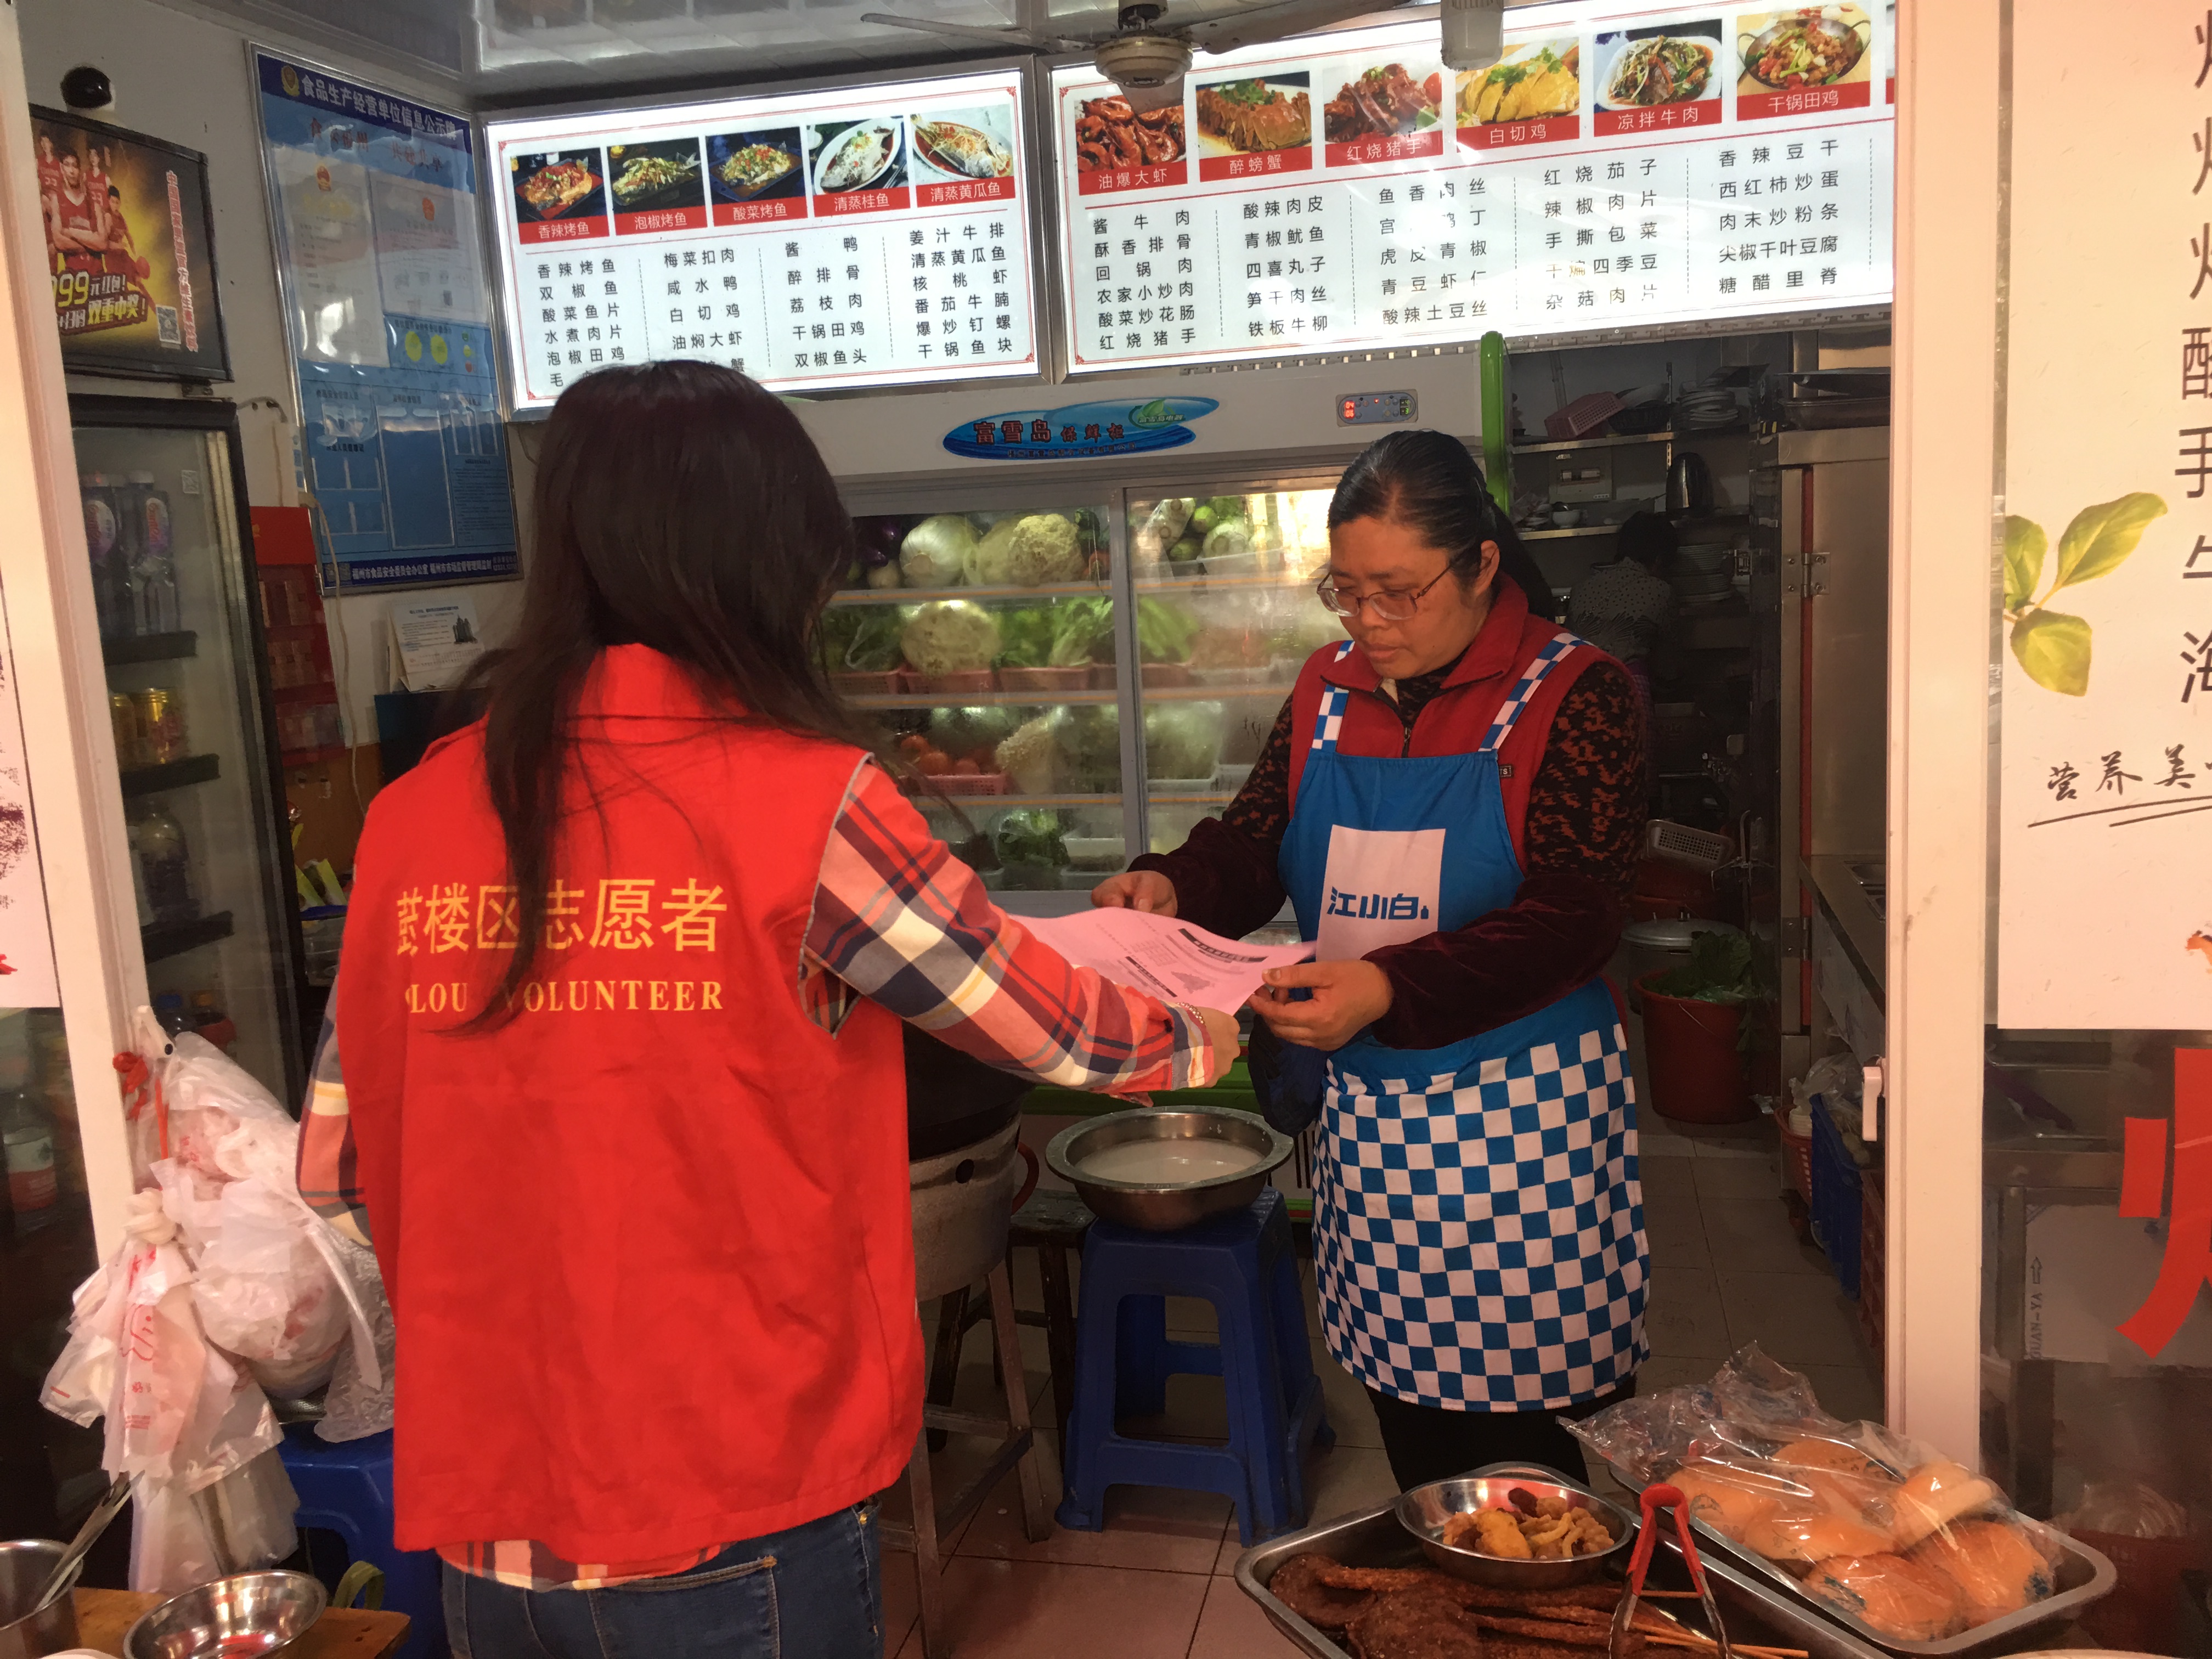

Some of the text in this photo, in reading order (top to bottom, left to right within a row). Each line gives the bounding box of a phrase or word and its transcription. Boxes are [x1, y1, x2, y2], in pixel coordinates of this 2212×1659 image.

[1768, 89, 1838, 113] 干锅田鸡
[1618, 107, 1698, 129] 凉拌牛肉
[1490, 123, 1546, 144] 白切鸡
[1347, 138, 1421, 160] 红烧猪手
[1719, 140, 1838, 167] 香辣豆干
[1229, 154, 1282, 174] 醉螃蟹
[1544, 159, 1657, 185] 红烧茄子
[1098, 168, 1167, 189] 油爆大虾
[1719, 171, 1838, 199] 西红柿炒蛋
[834, 193, 890, 211] 清蒸桂鱼
[930, 182, 1001, 202] 清蒸黄瓜鱼
[1379, 178, 1485, 204] 鱼香肉丝
[732, 203, 788, 220] 酸菜烤鱼
[1243, 195, 1323, 220] 酸辣肉皮
[1545, 190, 1657, 218] 辣椒肉片
[634, 212, 688, 230] 泡椒烤鱼
[1093, 210, 1189, 234] 酱牛肉
[1380, 210, 1486, 235] 宫丁
[1719, 202, 1838, 230] 肉末炒粉条
[538, 222, 590, 239] 香辣烤鱼
[909, 222, 1004, 246] 姜汁牛排
[1244, 226, 1324, 249] 青椒鱿鱼
[1545, 222, 1657, 249] 手撕包菜
[785, 236, 858, 257] 酱鸭
[911, 245, 1006, 268] 清蒸黄瓜鱼
[1094, 234, 1191, 258] 酥香排骨
[1381, 240, 1486, 265] 虎皮青椒
[538, 258, 616, 279] 香辣烤鱼
[664, 247, 735, 268] 梅菜扣肉
[1246, 256, 1325, 279] 四喜丸子
[1546, 254, 1657, 279] 干煸四季豆
[788, 265, 860, 285] 醉排骨
[913, 269, 1007, 291] 核桃虾
[1096, 258, 1192, 281] 回锅肉
[540, 280, 618, 301] 双椒鱼
[667, 276, 738, 296] 咸水鸭
[1097, 281, 1193, 303] 农家小炒肉
[1381, 270, 1486, 295] 青豆虾仁
[1719, 268, 1837, 294] 糖醋里脊
[790, 294, 862, 313] 荔枝肉
[915, 292, 1009, 313] 番茄牛腩
[1247, 286, 1327, 308] 笋干肉丝
[1547, 284, 1657, 309] 杂菇肉片
[542, 303, 620, 323] 酸菜鱼片
[670, 303, 740, 323] 白切鸡
[1098, 305, 1194, 328] 酸菜炒花肠
[1383, 300, 1487, 324] 酸辣土豆丝
[545, 325, 622, 344] 水煮肉片
[793, 321, 865, 341] 干锅田鸡
[916, 314, 1011, 336] 爆炒钉螺
[1249, 316, 1327, 337] 铁板牛柳
[673, 330, 742, 350] 油焖大虾
[918, 337, 1012, 359] 干锅鱼块
[1099, 328, 1195, 351] 红烧猪手
[547, 346, 625, 365] 泡椒田鸡
[795, 348, 867, 369] 双椒鱼头
[973, 419, 1125, 445] 富雪岛 保鲜柜
[2047, 743, 2212, 802] 营养美
[1327, 888, 1419, 920] 江小白
[404, 983, 468, 1013] LOU
